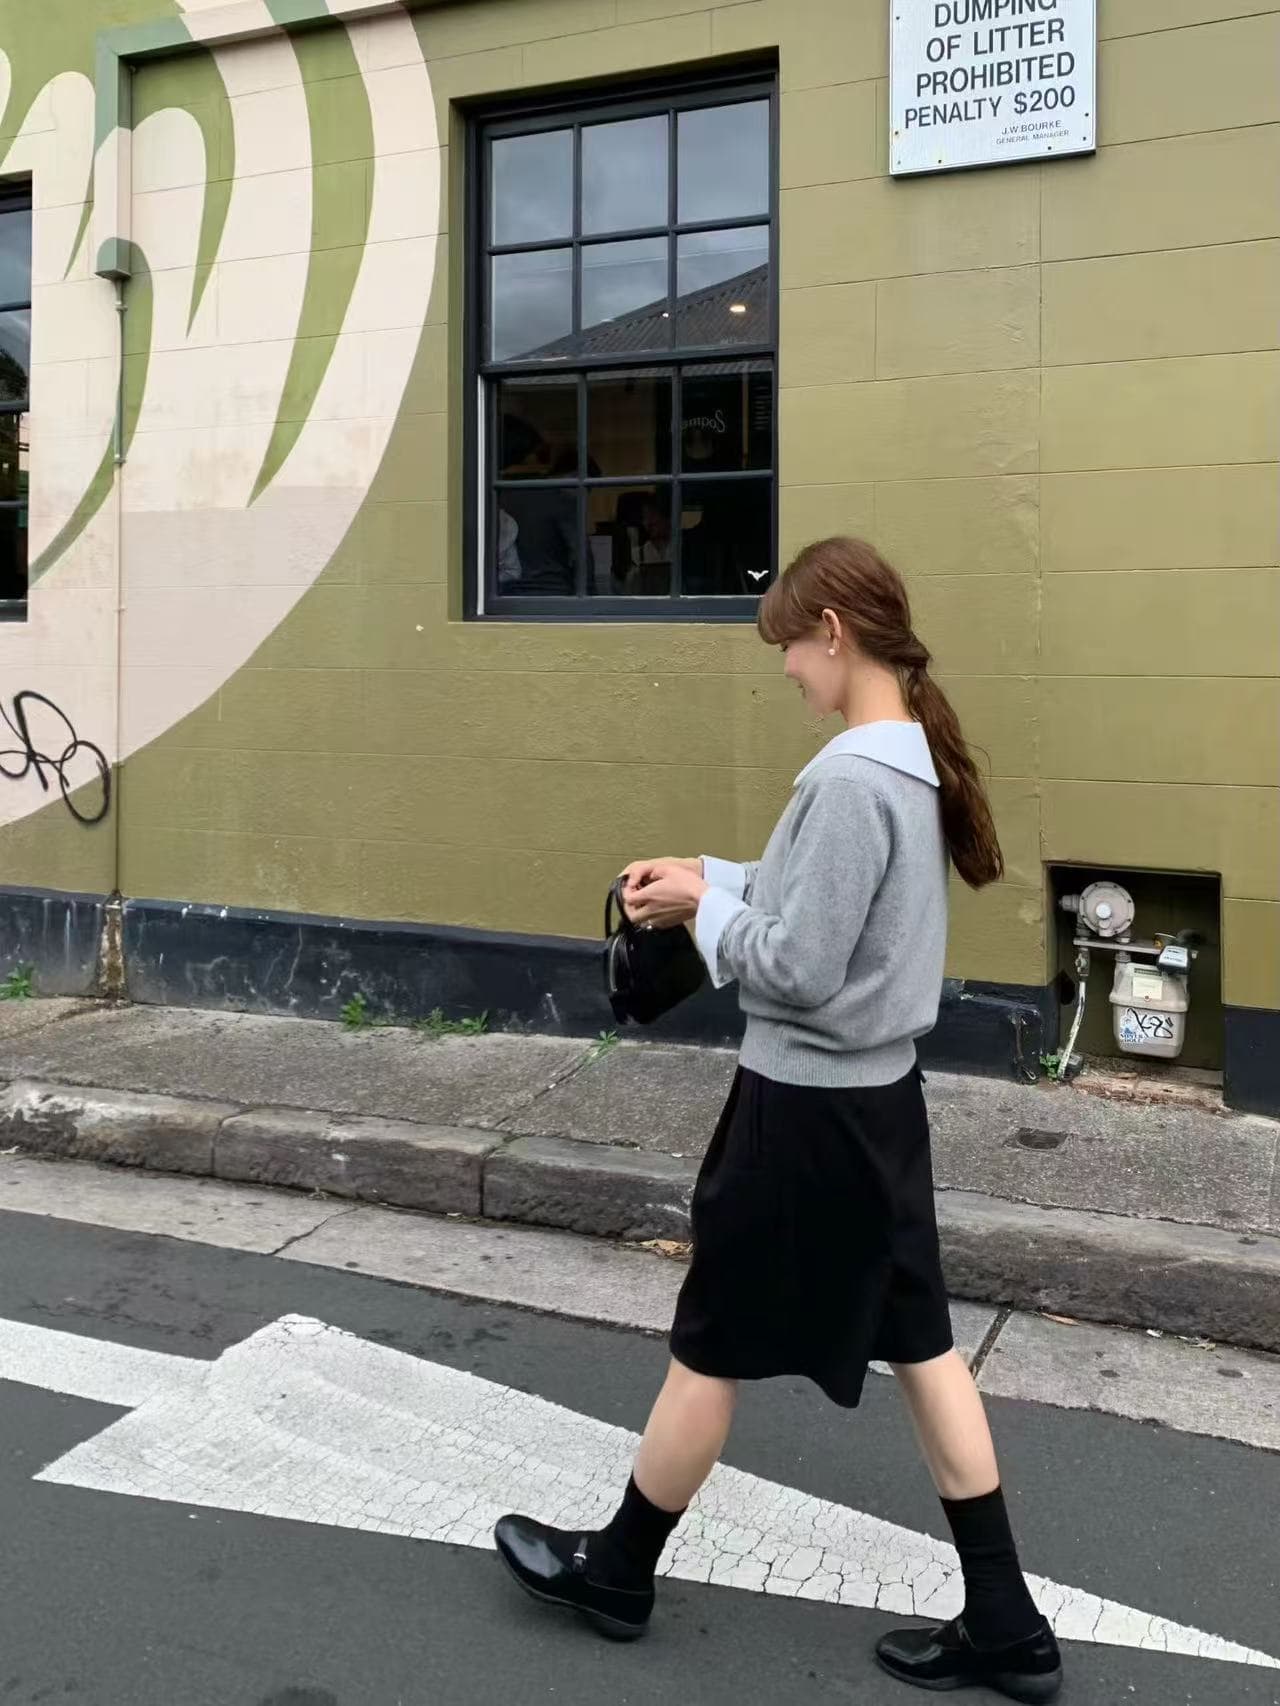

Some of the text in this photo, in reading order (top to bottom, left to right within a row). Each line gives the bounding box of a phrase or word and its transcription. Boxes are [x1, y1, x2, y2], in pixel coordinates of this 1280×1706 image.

[926, 17, 1065, 62] OF LITTER
[916, 51, 1075, 97] PROHIBITED
[905, 85, 1075, 128] PENALTY $200
